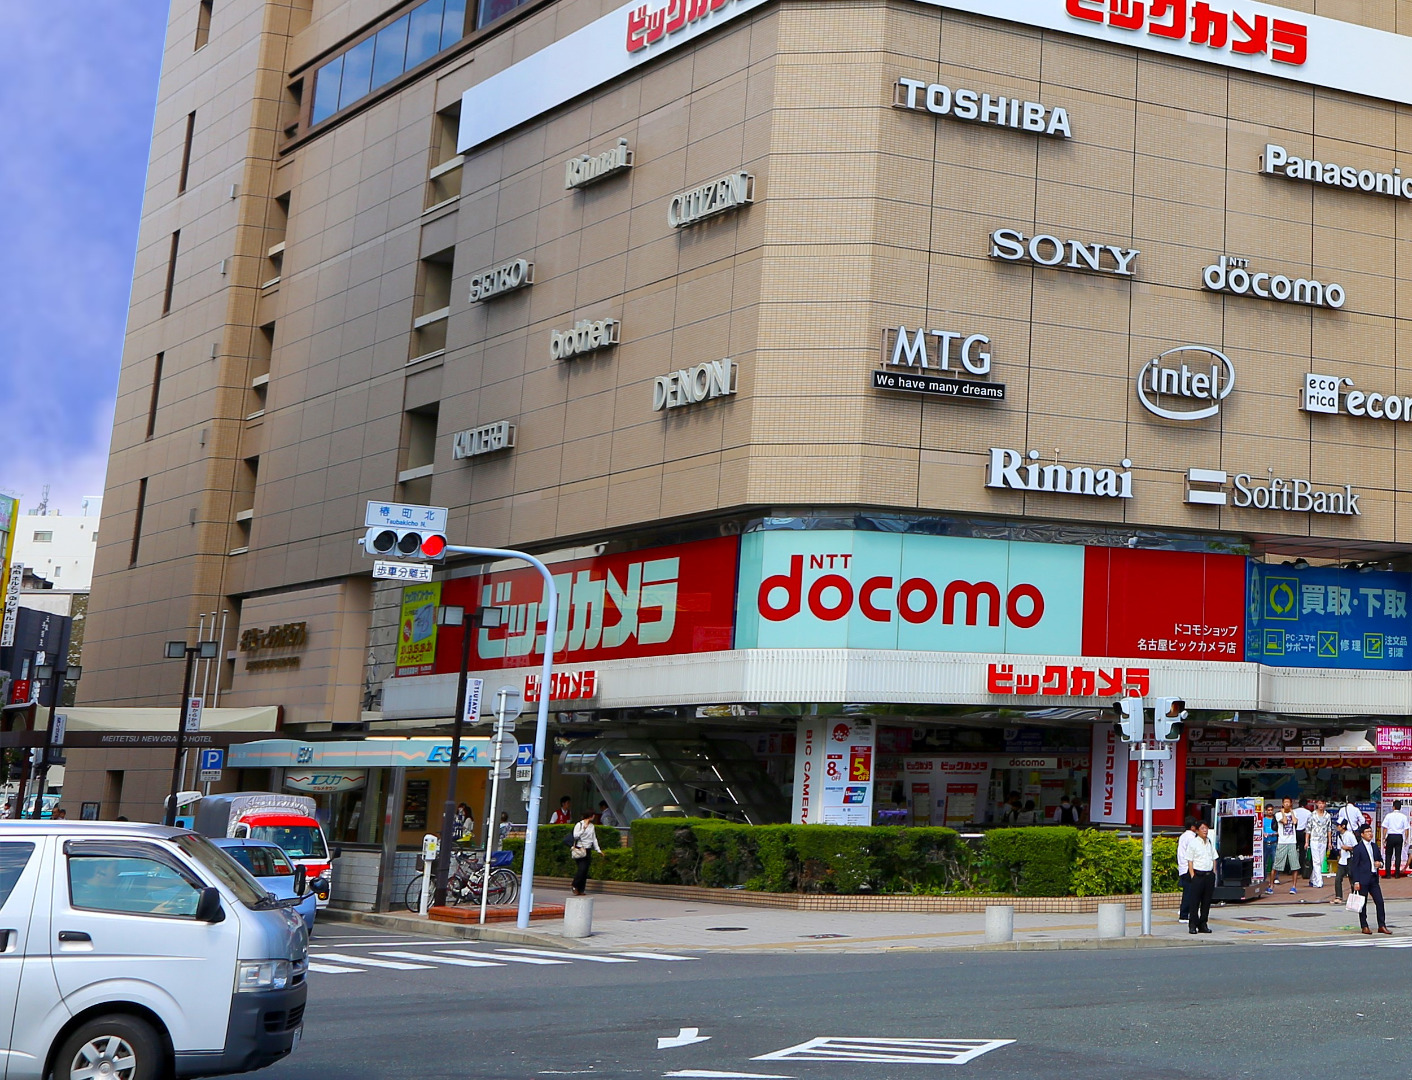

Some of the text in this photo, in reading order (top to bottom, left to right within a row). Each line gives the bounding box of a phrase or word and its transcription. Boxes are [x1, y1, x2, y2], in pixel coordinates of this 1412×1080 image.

[899, 77, 1073, 139] TOSHIBA
[667, 170, 749, 229] CITIZEN
[991, 228, 1141, 275] SONY
[1228, 257, 1250, 268] NTT
[469, 258, 527, 303] SEIKO
[1203, 255, 1346, 308] docomo
[549, 317, 614, 361] brother
[890, 325, 992, 375] MTG
[652, 357, 732, 412] DENON
[875, 374, 1004, 399] We have many dreams
[1148, 357, 1220, 400] intel
[1307, 377, 1337, 392] eco
[1307, 393, 1337, 409] rica
[988, 447, 1133, 498] Rinnai
[1232, 472, 1362, 515] SoftBank
[379, 505, 435, 521] 椿町北
[376, 565, 429, 579] 歩車分離式
[809, 553, 853, 570] NTT
[757, 554, 1045, 629] docomo
[477, 556, 681, 660] ビックカメラ
[1173, 622, 1239, 638] ドコモショップ
[1136, 637, 1237, 655] 名古屋ビックカメラ店
[1285, 642, 1316, 653] サポート
[1340, 639, 1361, 652] 修理
[987, 663, 1151, 697] ビックカメラ
[101, 735, 140, 743] MEITETSU
[804, 729, 813, 756] BIC
[1284, 730, 1295, 739] 5F
[207, 751, 220, 768] P
[426, 745, 478, 763] ESA
[1008, 757, 1046, 767] docomo
[306, 774, 342, 786] エスカ
